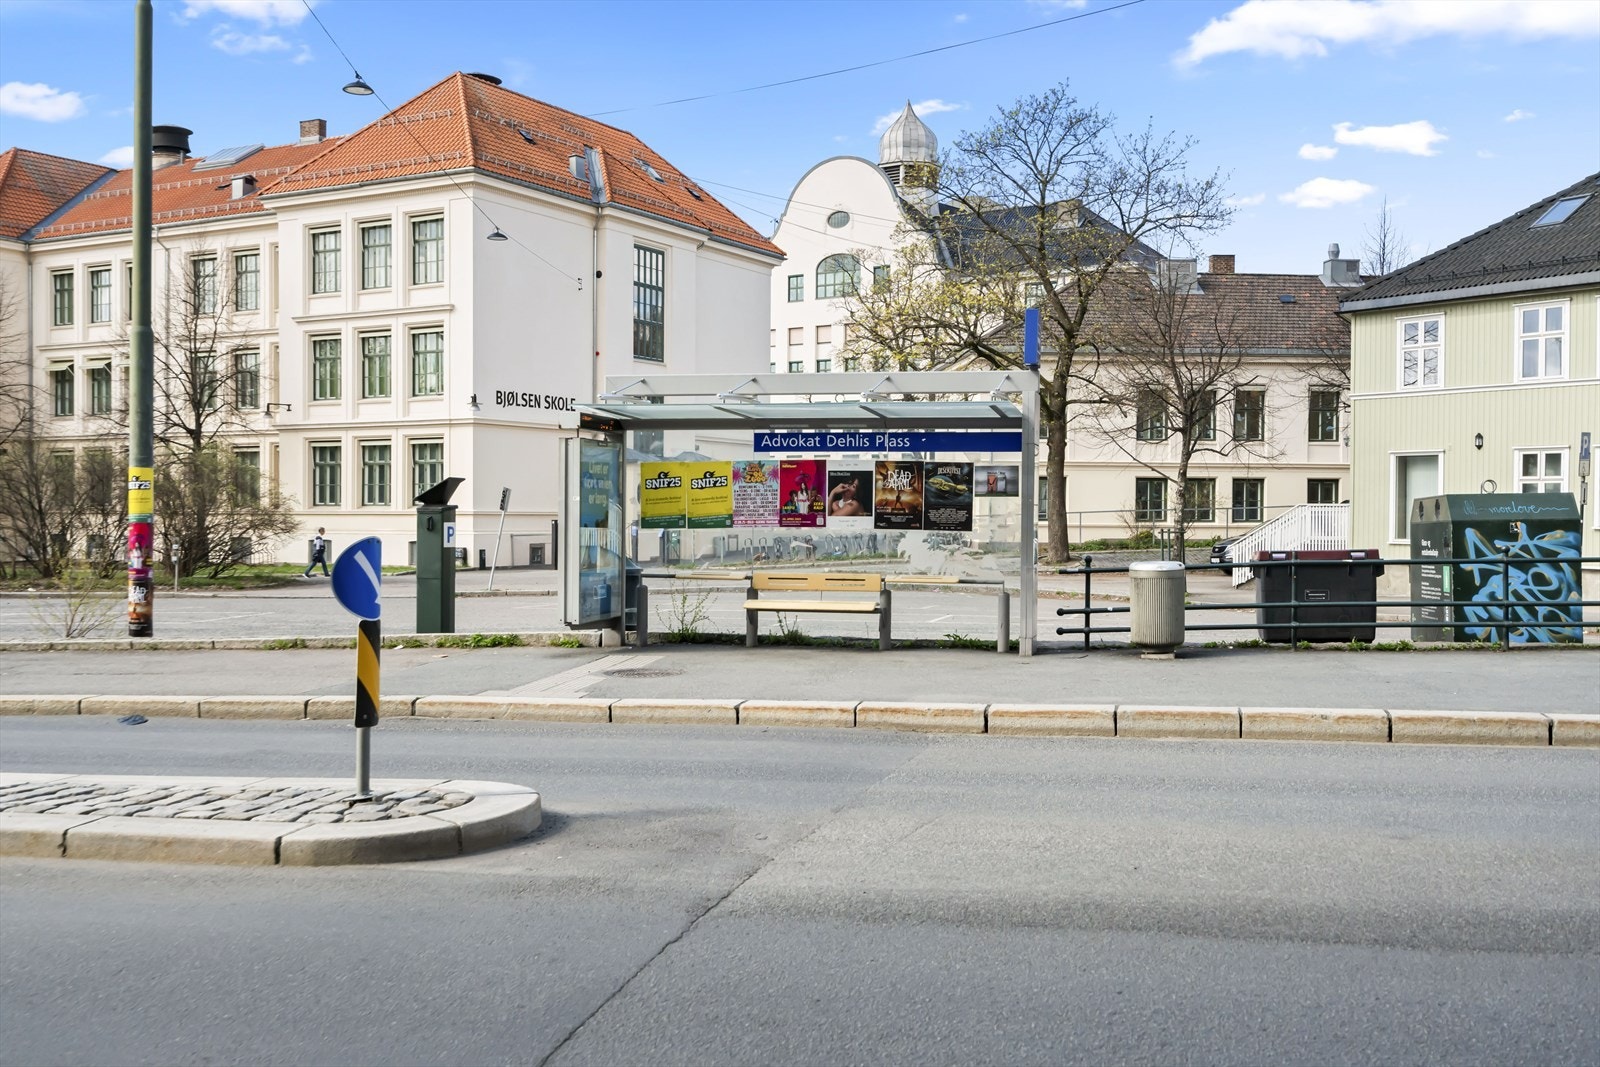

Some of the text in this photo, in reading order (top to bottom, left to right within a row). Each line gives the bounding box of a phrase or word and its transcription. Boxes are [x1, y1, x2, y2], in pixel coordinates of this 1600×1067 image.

[496, 390, 576, 412] BJØLSEN SKOLE
[761, 434, 910, 447] Advokat Dehlis Plass
[1582, 435, 1589, 456] P
[887, 469, 912, 482] DEAD
[645, 477, 681, 489] SNIF25
[691, 477, 727, 489] SNIF25
[447, 526, 454, 543] P
